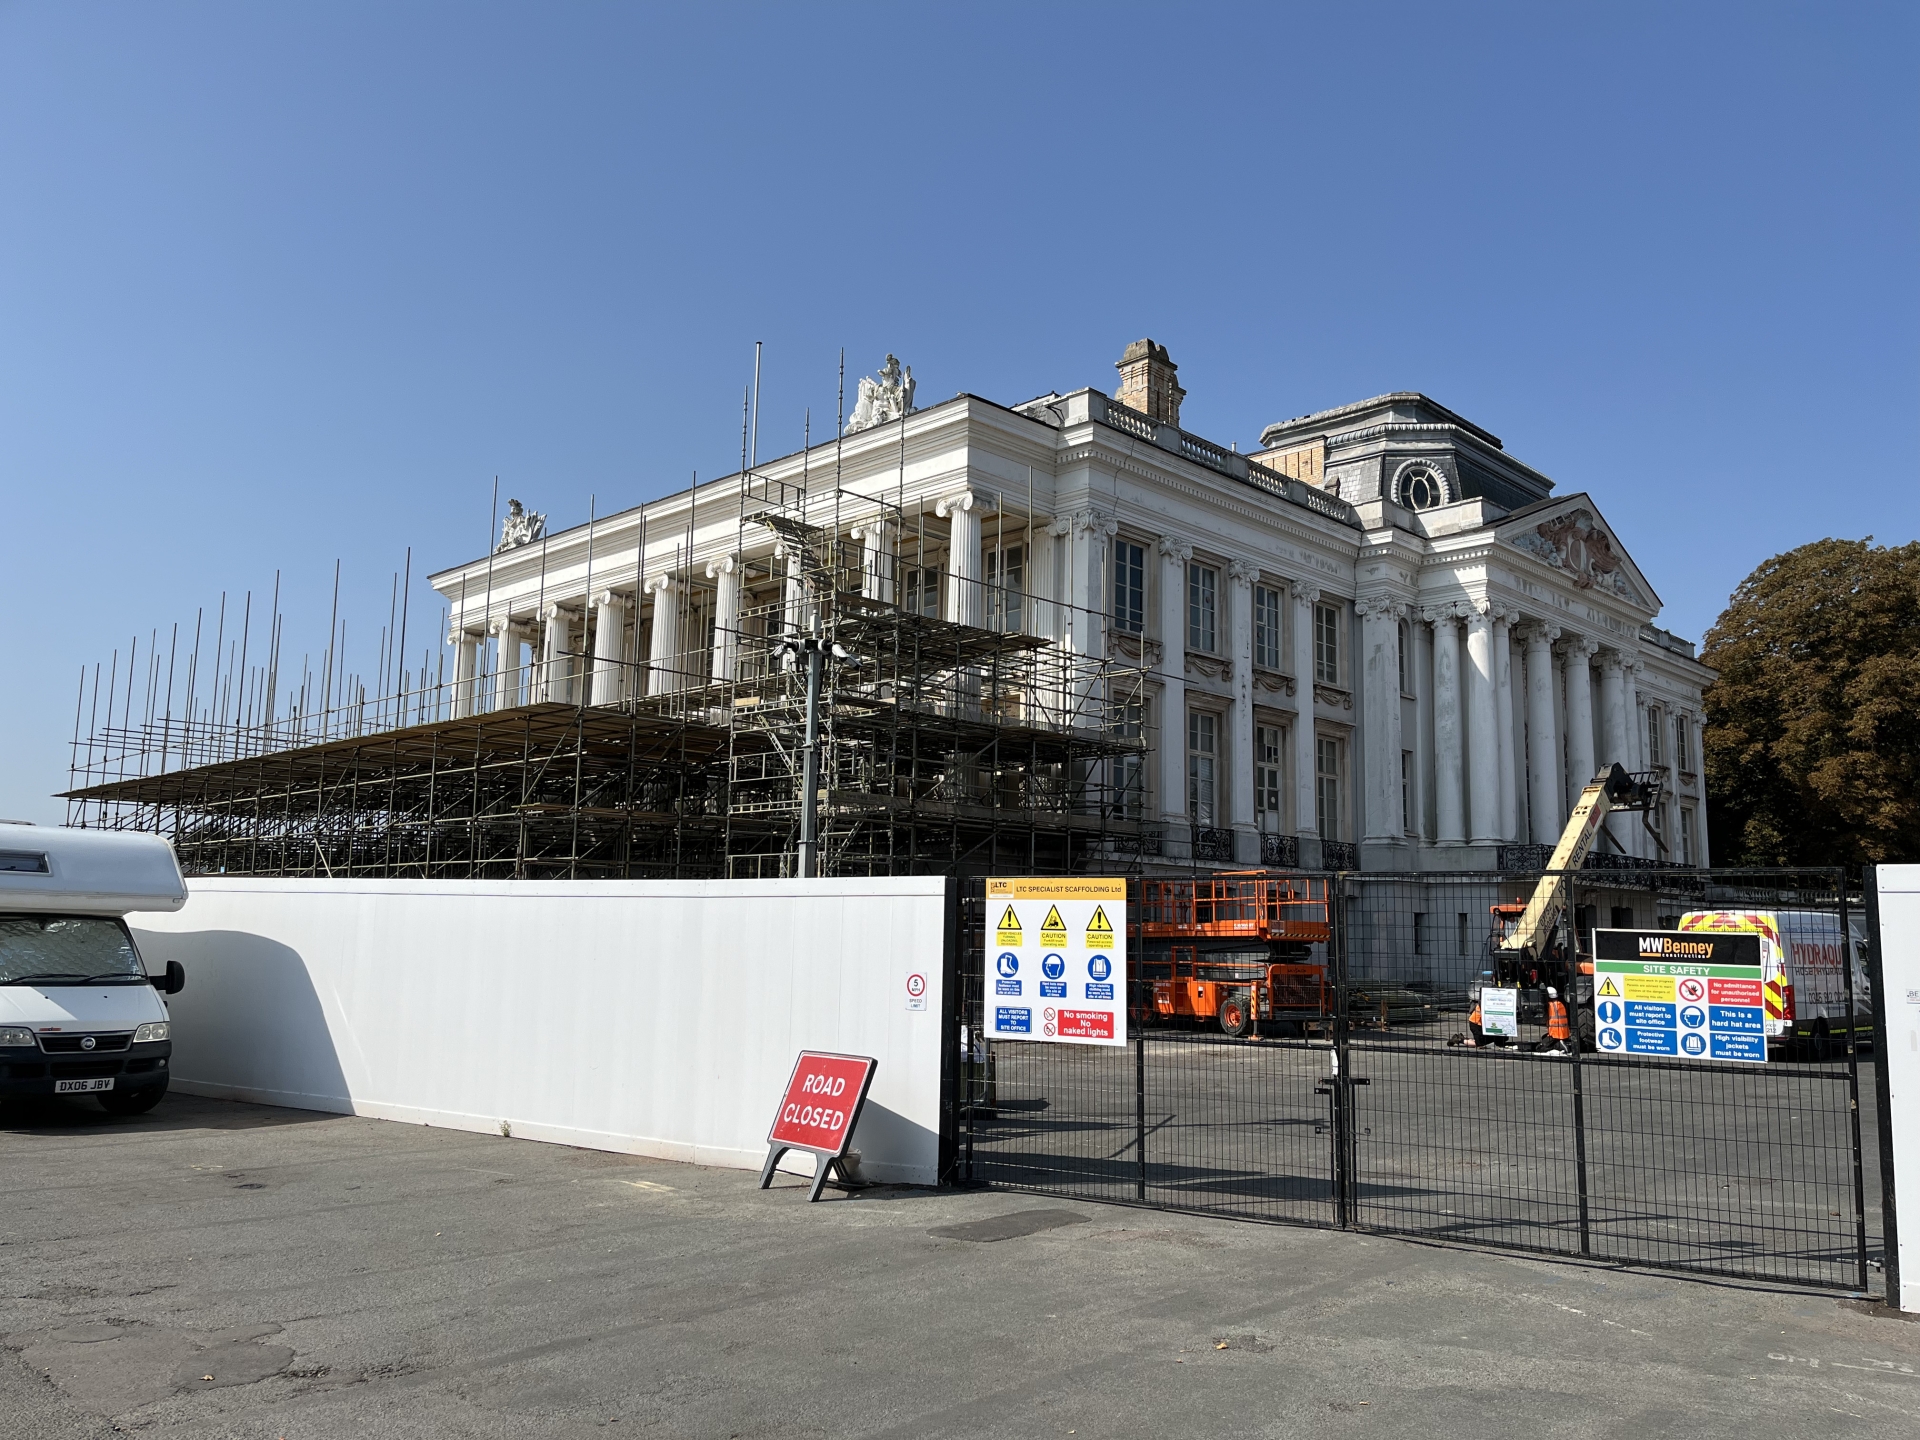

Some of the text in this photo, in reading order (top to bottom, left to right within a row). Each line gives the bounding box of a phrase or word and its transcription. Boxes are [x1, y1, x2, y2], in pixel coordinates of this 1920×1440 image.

[1572, 828, 1592, 866] RENTAL
[1792, 943, 1842, 966] HYDRAQU
[1643, 965, 1710, 975] SITE SAFETY
[914, 979, 918, 987] 5
[1076, 1012, 1108, 1022] smoking
[1088, 1028, 1108, 1037] lights
[60, 1080, 110, 1091] DX06 JBV
[802, 1074, 846, 1096] ROAD
[784, 1103, 844, 1130] CLOSED
